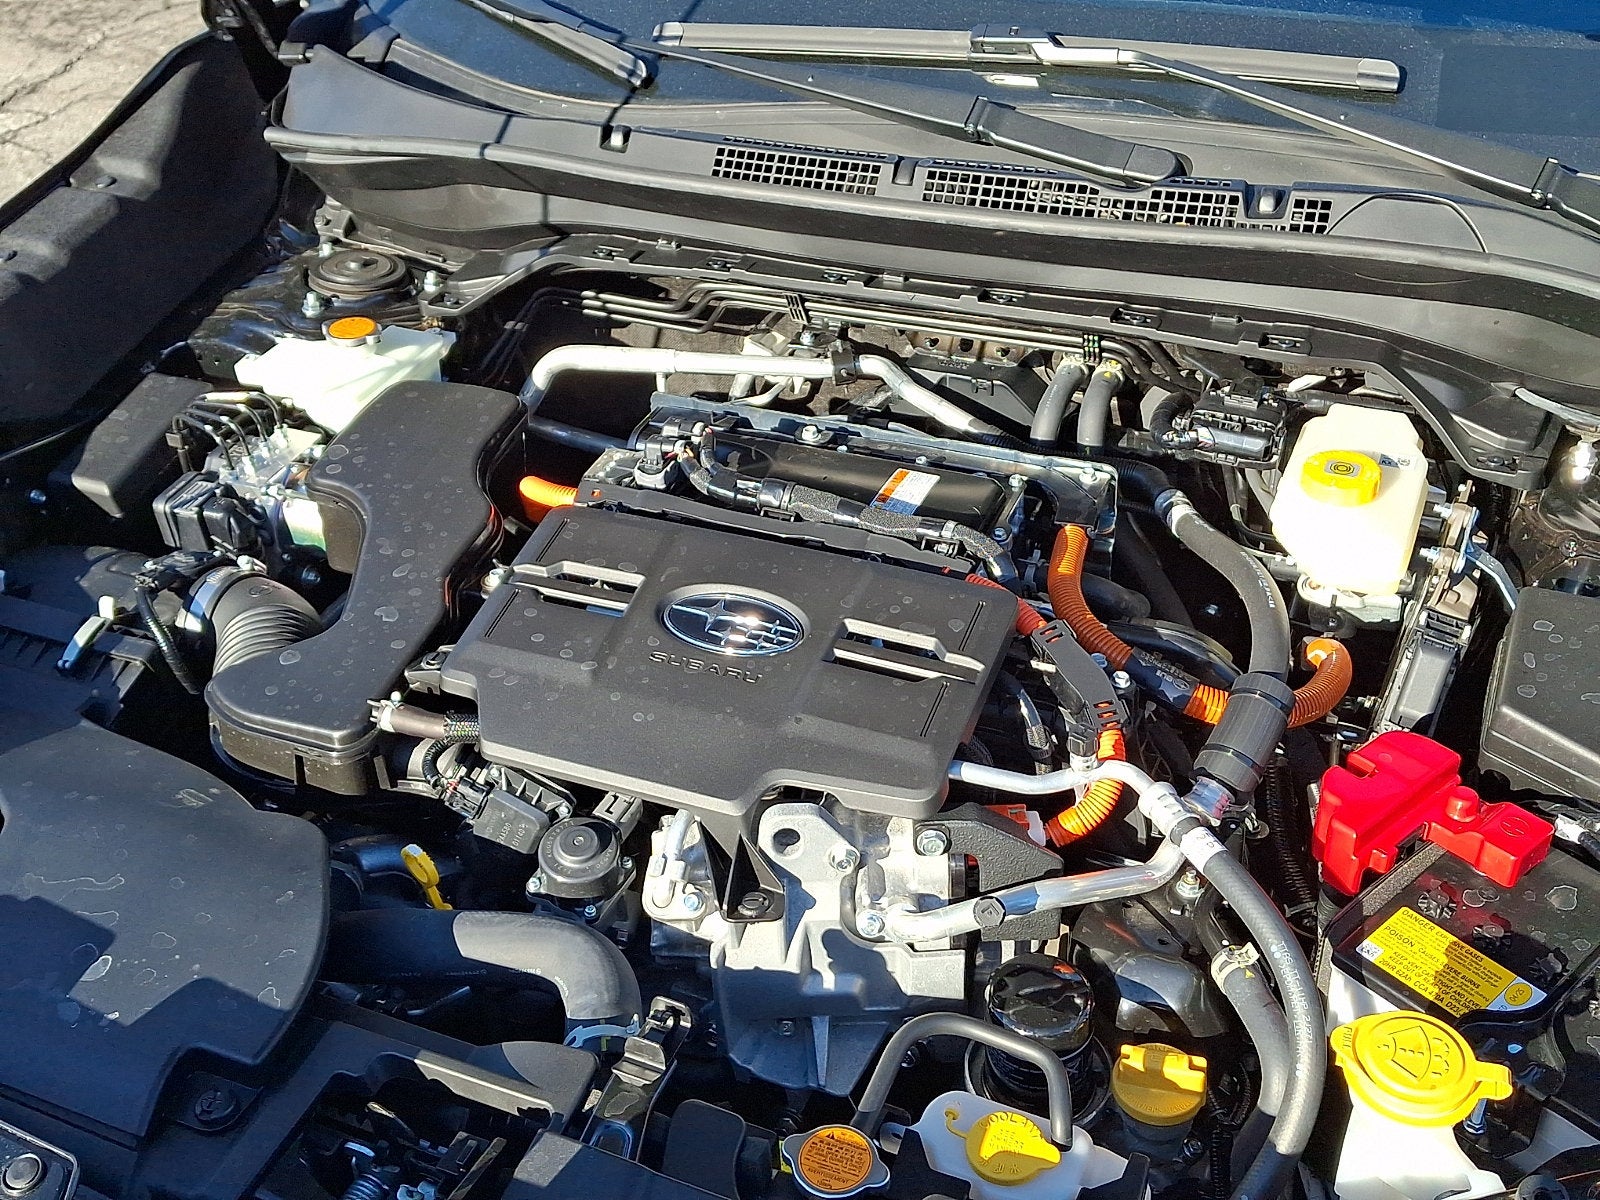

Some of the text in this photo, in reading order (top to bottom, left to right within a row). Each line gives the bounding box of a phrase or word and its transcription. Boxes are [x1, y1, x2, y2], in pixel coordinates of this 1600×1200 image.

[648, 651, 763, 684] SUBARU
[1402, 909, 1435, 932] DANGER
[1464, 946, 1484, 963] GASES
[1384, 925, 1415, 947] POISON
[1461, 975, 1481, 989] BURNS
[1414, 980, 1428, 992] CCA
[1437, 979, 1453, 991] TIGHT
[1453, 990, 1465, 999] AND
